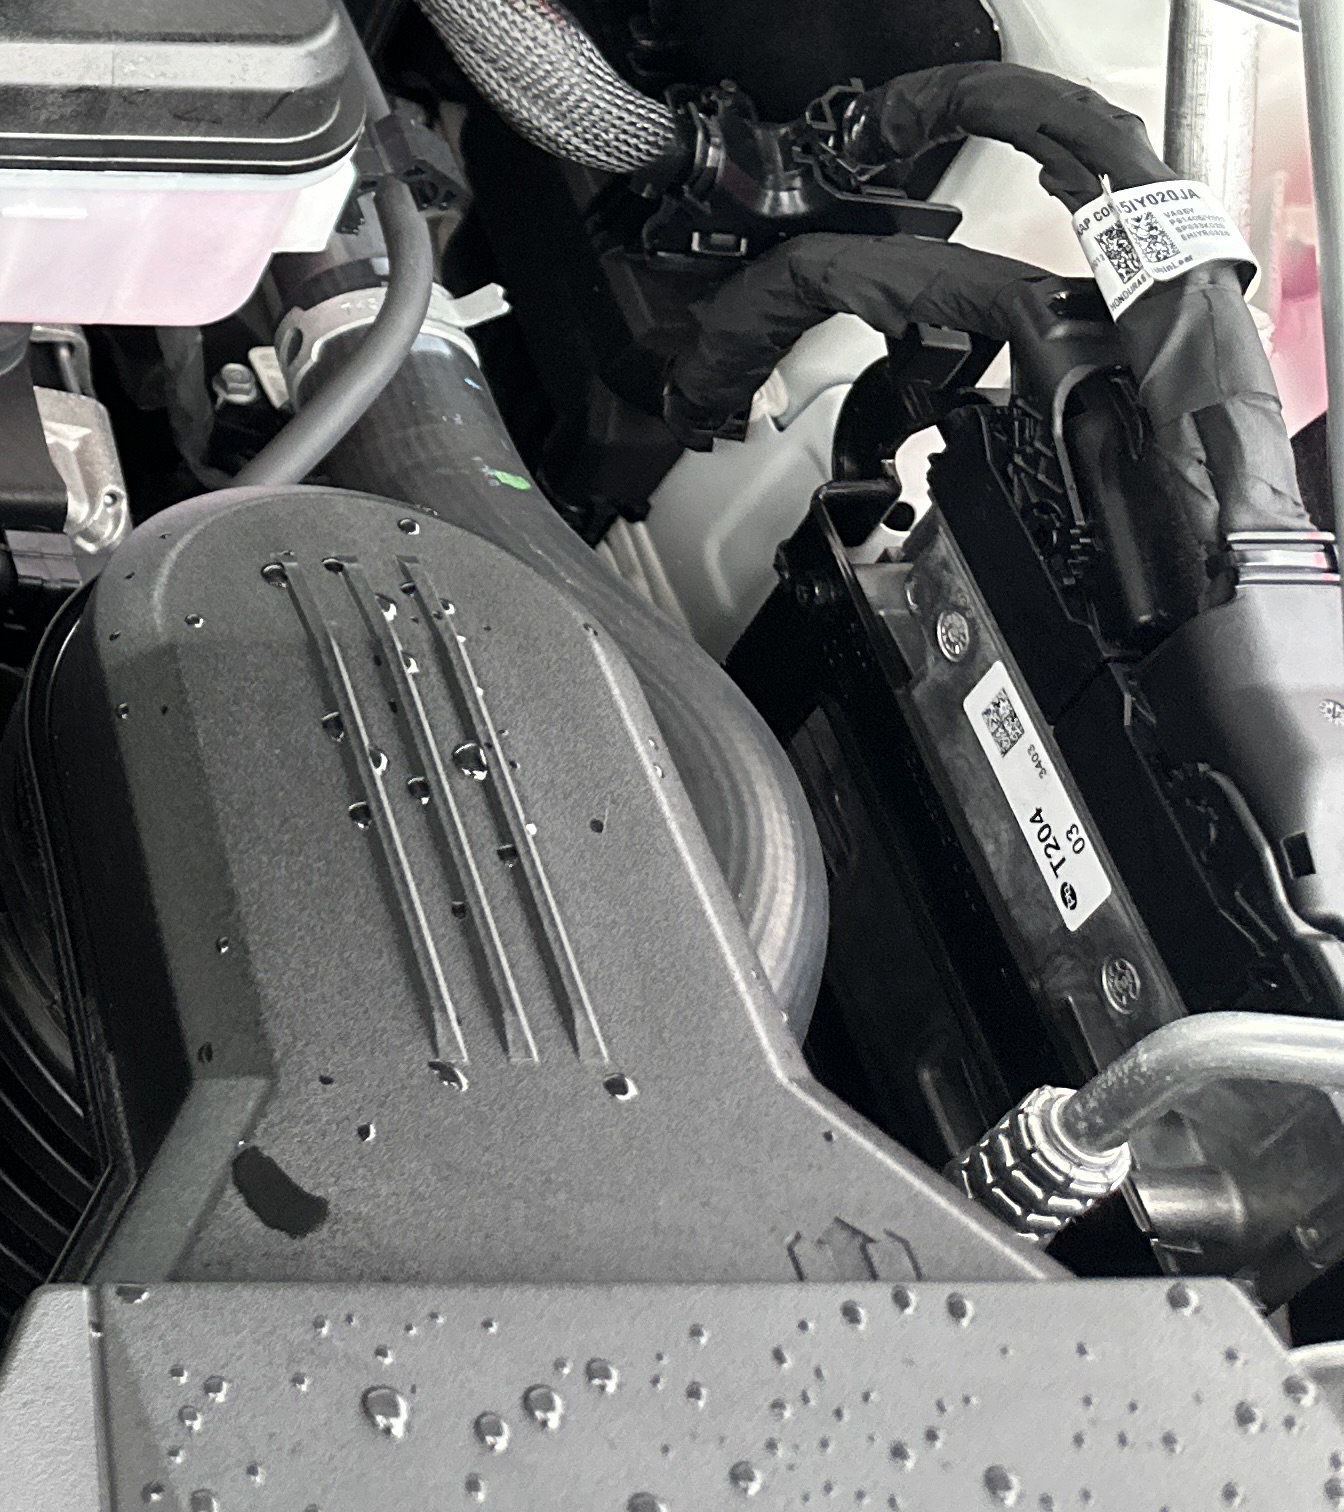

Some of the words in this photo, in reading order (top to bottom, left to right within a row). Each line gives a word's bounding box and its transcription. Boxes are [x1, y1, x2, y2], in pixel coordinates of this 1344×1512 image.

[1027, 743, 1047, 779] 3403
[1029, 806, 1067, 879] T204
[1066, 823, 1086, 855] 03
